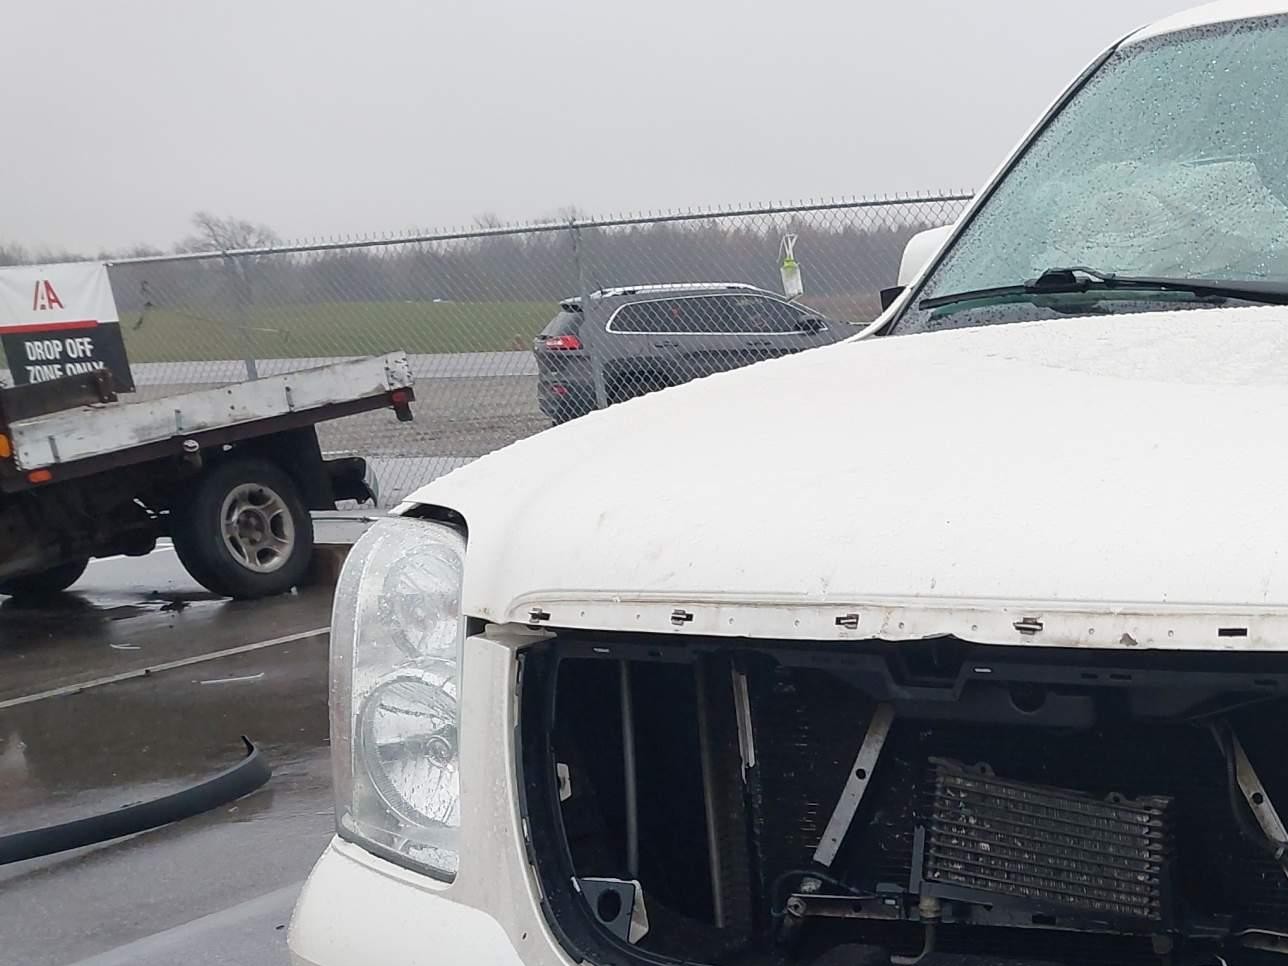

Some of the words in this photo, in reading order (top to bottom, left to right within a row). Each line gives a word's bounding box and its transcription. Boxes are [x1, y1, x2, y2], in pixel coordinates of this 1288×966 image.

[24, 339, 63, 361] DROP
[65, 337, 94, 359] OFF
[25, 363, 63, 385] ZONE
